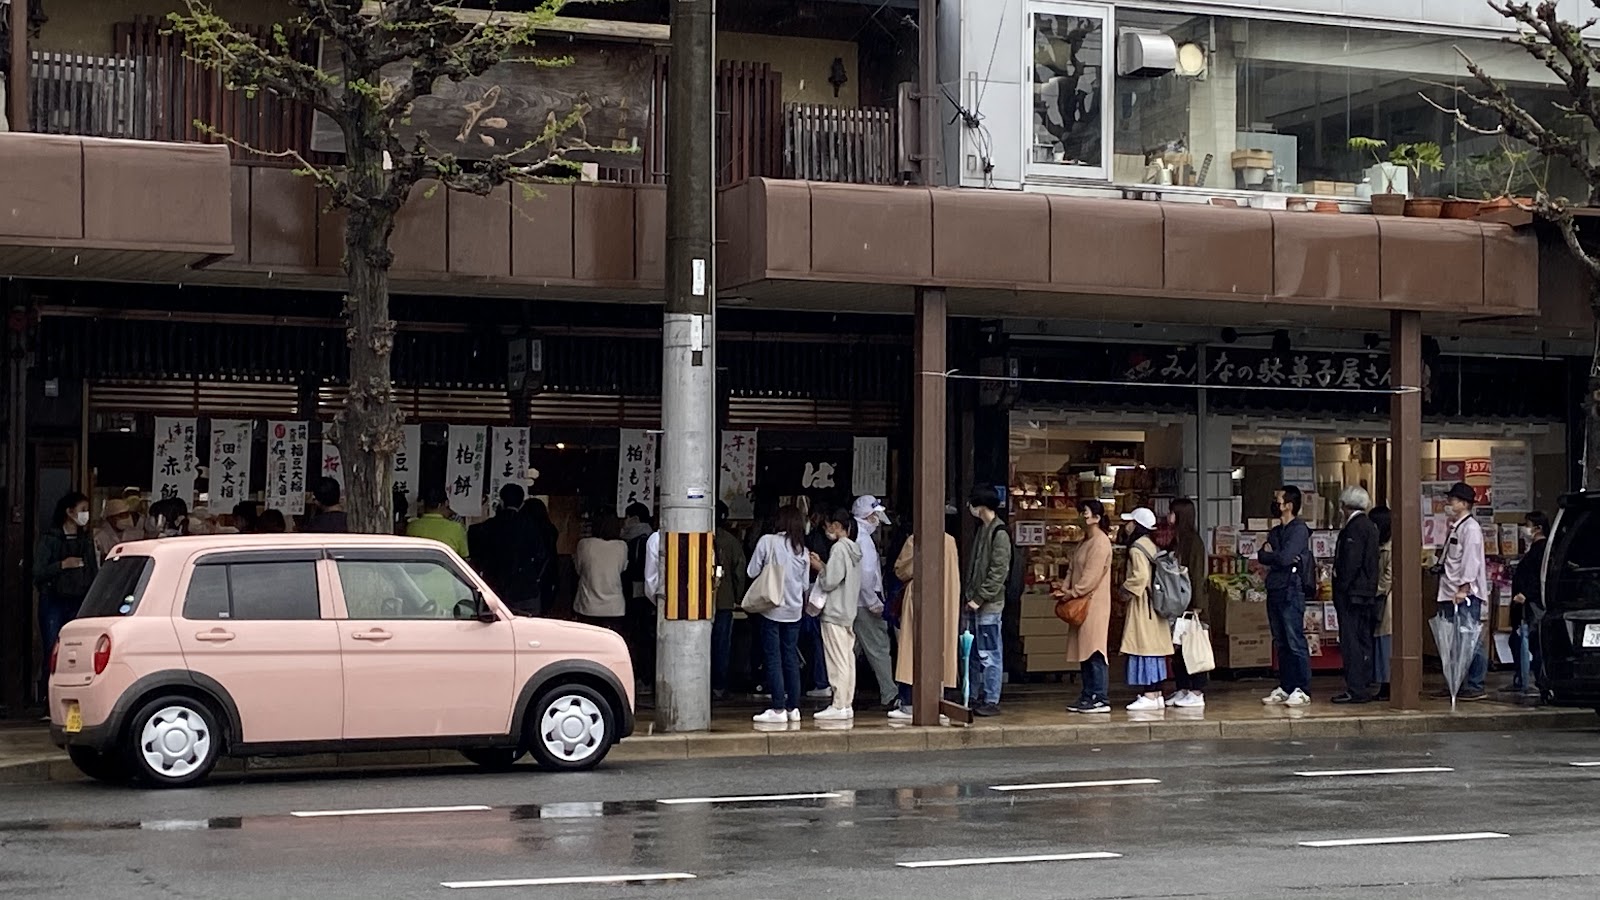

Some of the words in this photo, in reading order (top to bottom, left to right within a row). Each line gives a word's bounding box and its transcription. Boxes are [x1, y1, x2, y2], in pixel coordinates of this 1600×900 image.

[160, 455, 181, 500] 赤飯
[220, 443, 237, 498] 田舎大福
[454, 442, 474, 498] 柏餅
